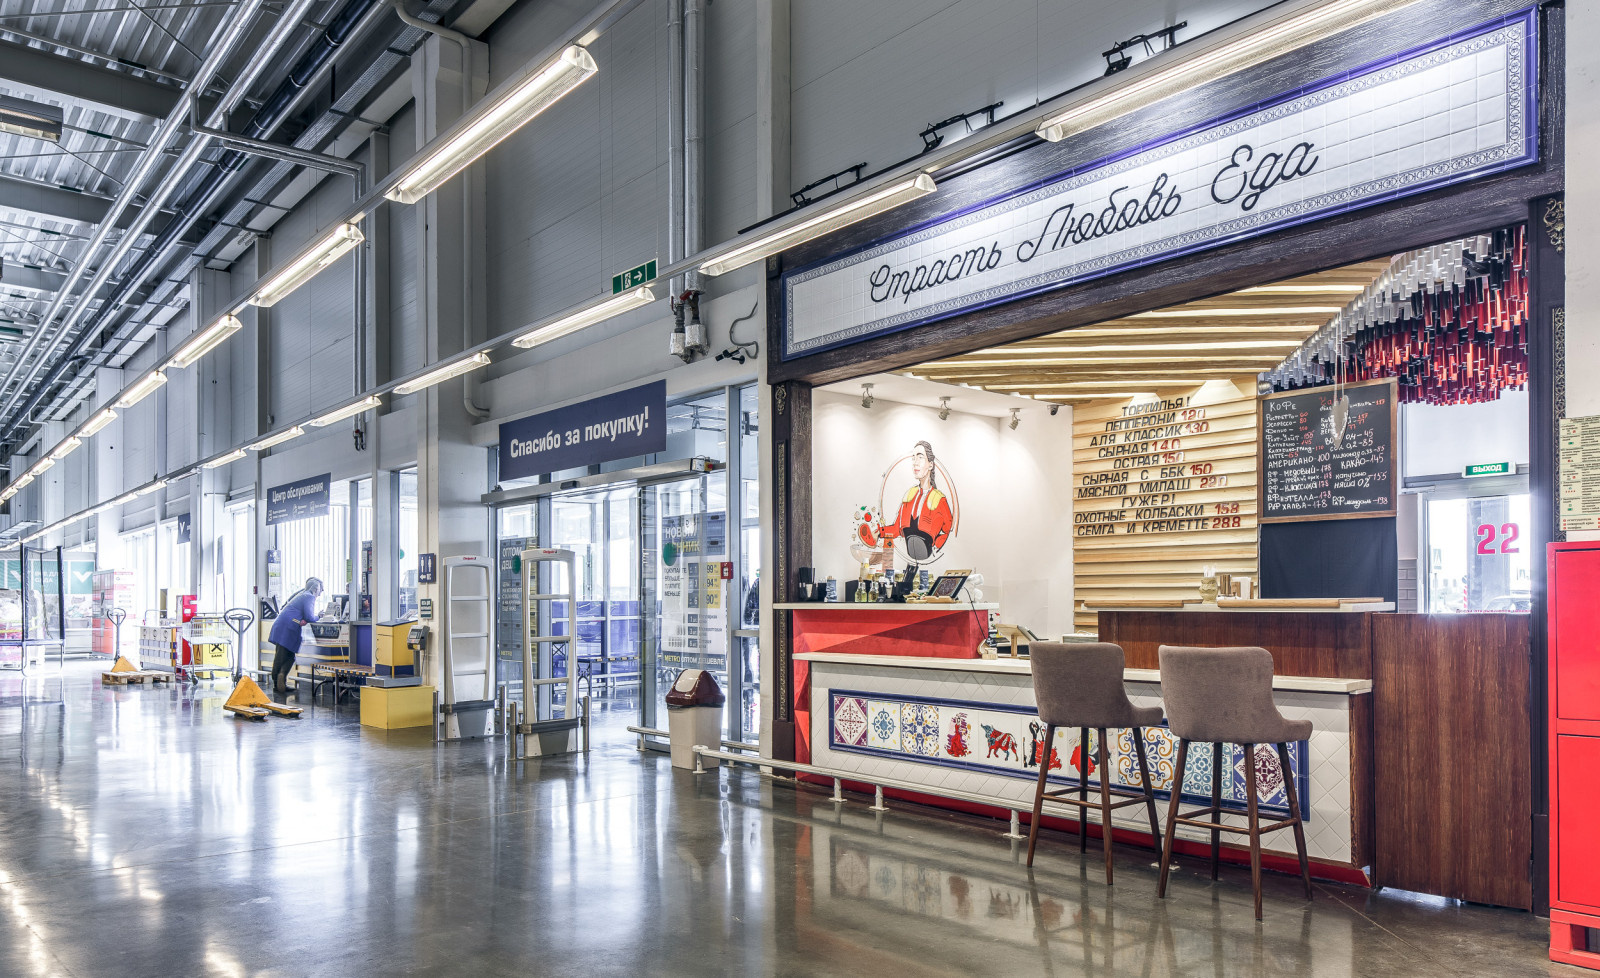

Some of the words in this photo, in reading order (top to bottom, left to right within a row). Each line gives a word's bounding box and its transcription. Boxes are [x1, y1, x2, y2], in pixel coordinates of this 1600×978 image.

[869, 240, 1003, 305] Страсть
[1015, 172, 1183, 263] Любовь
[1210, 140, 1320, 212] Еда
[1122, 396, 1191, 416] ТОРТИЛЬЯ!
[510, 433, 561, 459] Спасибо
[565, 428, 580, 445] за
[584, 405, 650, 443] покупку!
[1105, 412, 1175, 431] ПЕППЕРОНИ
[1090, 434, 1116, 447] АЛЯ
[1124, 424, 1183, 442] КЛАССИК
[1185, 421, 1209, 433] 130
[1098, 442, 1148, 458] СЫРНАЯ
[1152, 438, 1181, 451] 140
[1113, 454, 1160, 469] ОСТРАЯ
[1472, 464, 1502, 473] ВЫХОД
[1082, 471, 1128, 486] СЫРНАЯ
[1140, 469, 1149, 480] С
[1160, 466, 1186, 478] ББК
[1190, 463, 1213, 475] 150
[272, 490, 287, 504] Центр
[287, 482, 324, 500] обслуживания
[1077, 484, 1127, 498] МЯСНОЙ
[1139, 479, 1191, 494] МИЛАШ
[1200, 476, 1227, 488] 220
[1121, 493, 1175, 508] ГУЖЕР!
[1074, 510, 1126, 524] ОХОТНЫЕ
[1135, 505, 1204, 519] КОЛБАСКИ
[1214, 502, 1239, 515] 158
[1077, 524, 1115, 536] СЕМГА
[1127, 523, 1136, 534] И
[1142, 518, 1209, 533] КРЕМЕТТЕ
[1212, 516, 1241, 529] 288
[1477, 522, 1519, 555] 22
[664, 655, 681, 663] METRO
